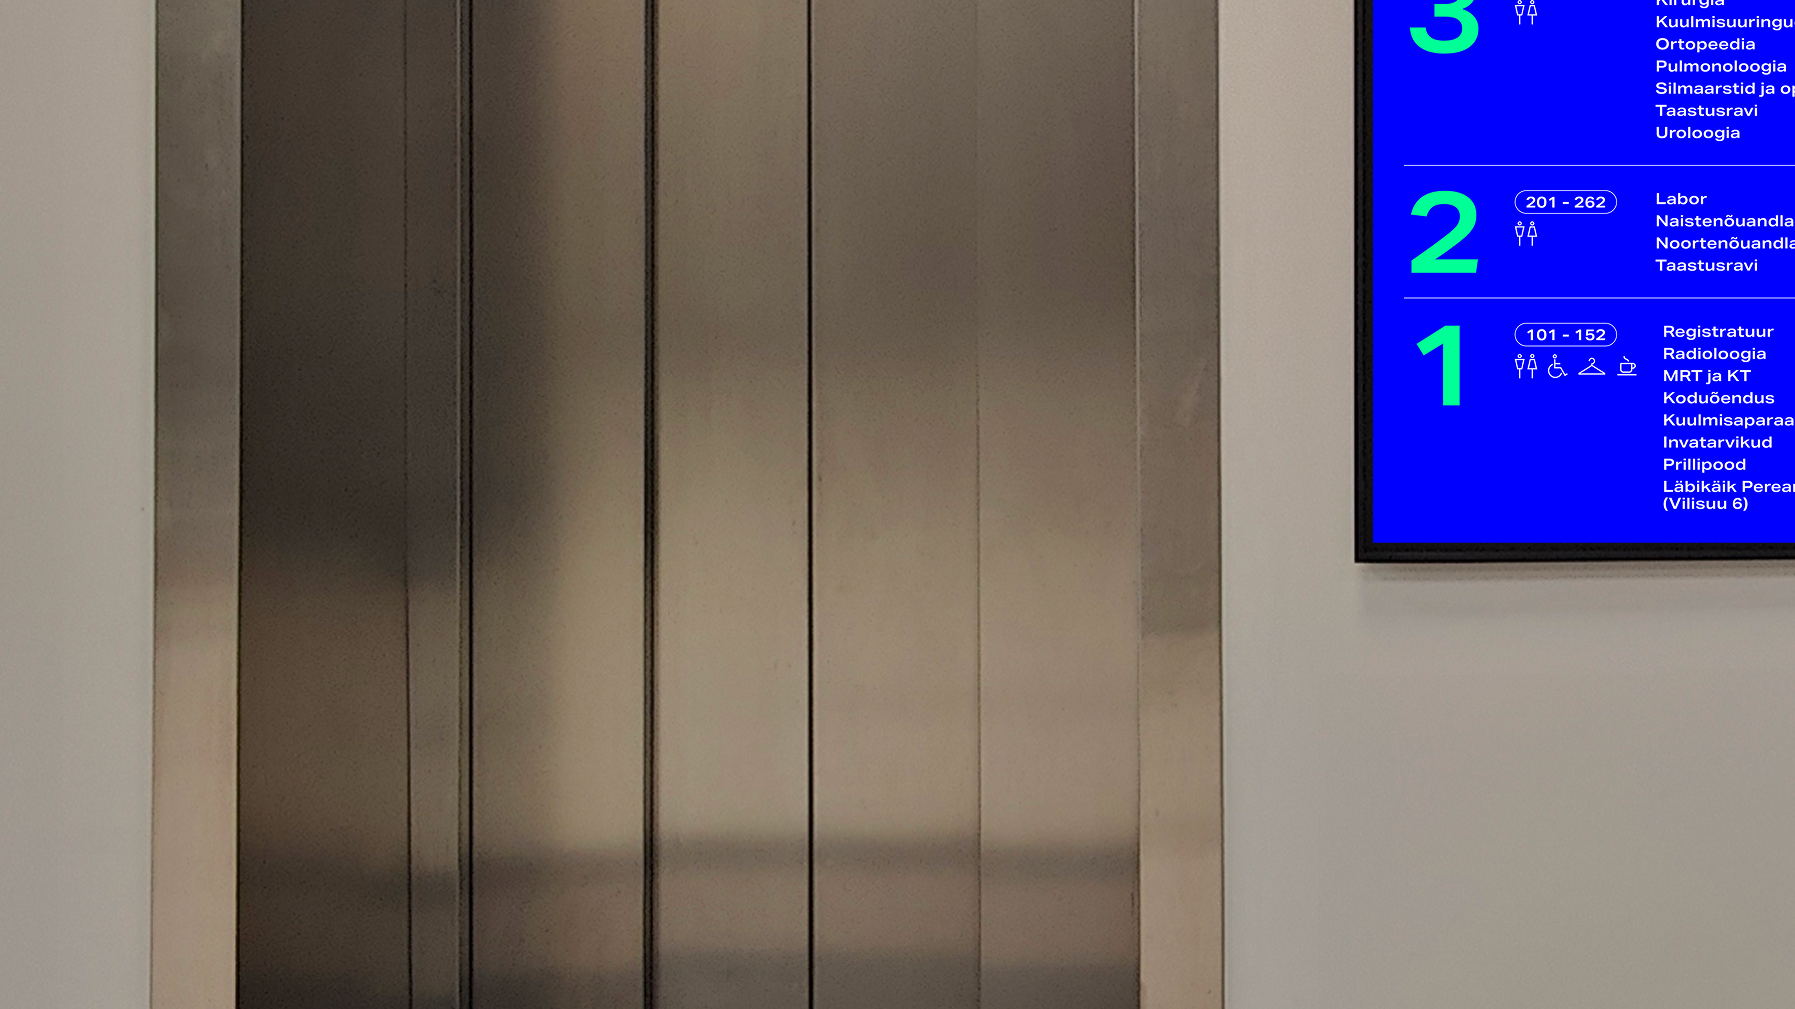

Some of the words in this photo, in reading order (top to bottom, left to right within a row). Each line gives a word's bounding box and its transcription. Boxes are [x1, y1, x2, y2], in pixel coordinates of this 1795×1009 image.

[1656, 38, 1755, 53] Ortopeedia
[1657, 60, 1786, 75] Pulmonoloogia
[1656, 82, 1755, 94] Silmaarstid
[1759, 82, 1774, 97] ja
[1655, 105, 1757, 116] Taastusravi
[1657, 127, 1740, 141] Uroloogia
[1526, 196, 1555, 208] 201
[1575, 196, 1605, 208] 262
[1657, 193, 1707, 205] Labor
[1657, 215, 1793, 227] Naistenõuandla
[1411, 191, 1478, 273] 2
[1655, 259, 1757, 271] Taastusravi
[1527, 329, 1555, 341] 101
[1576, 329, 1605, 341] 152
[1664, 326, 1774, 340] Registratuur
[1664, 348, 1766, 362] Radioloogia
[1417, 326, 1460, 405] 1
[1664, 370, 1703, 381] MRT
[1706, 370, 1721, 384] ja
[1728, 370, 1751, 381] KT
[1664, 392, 1774, 404] Koduõendus
[1664, 436, 1772, 448] Invatarvikud
[1664, 458, 1745, 473] Prillipood
[1664, 481, 1737, 492] Läbikäik
[1664, 497, 1726, 511] (Vilisuu
[1733, 497, 1748, 511] 6)
